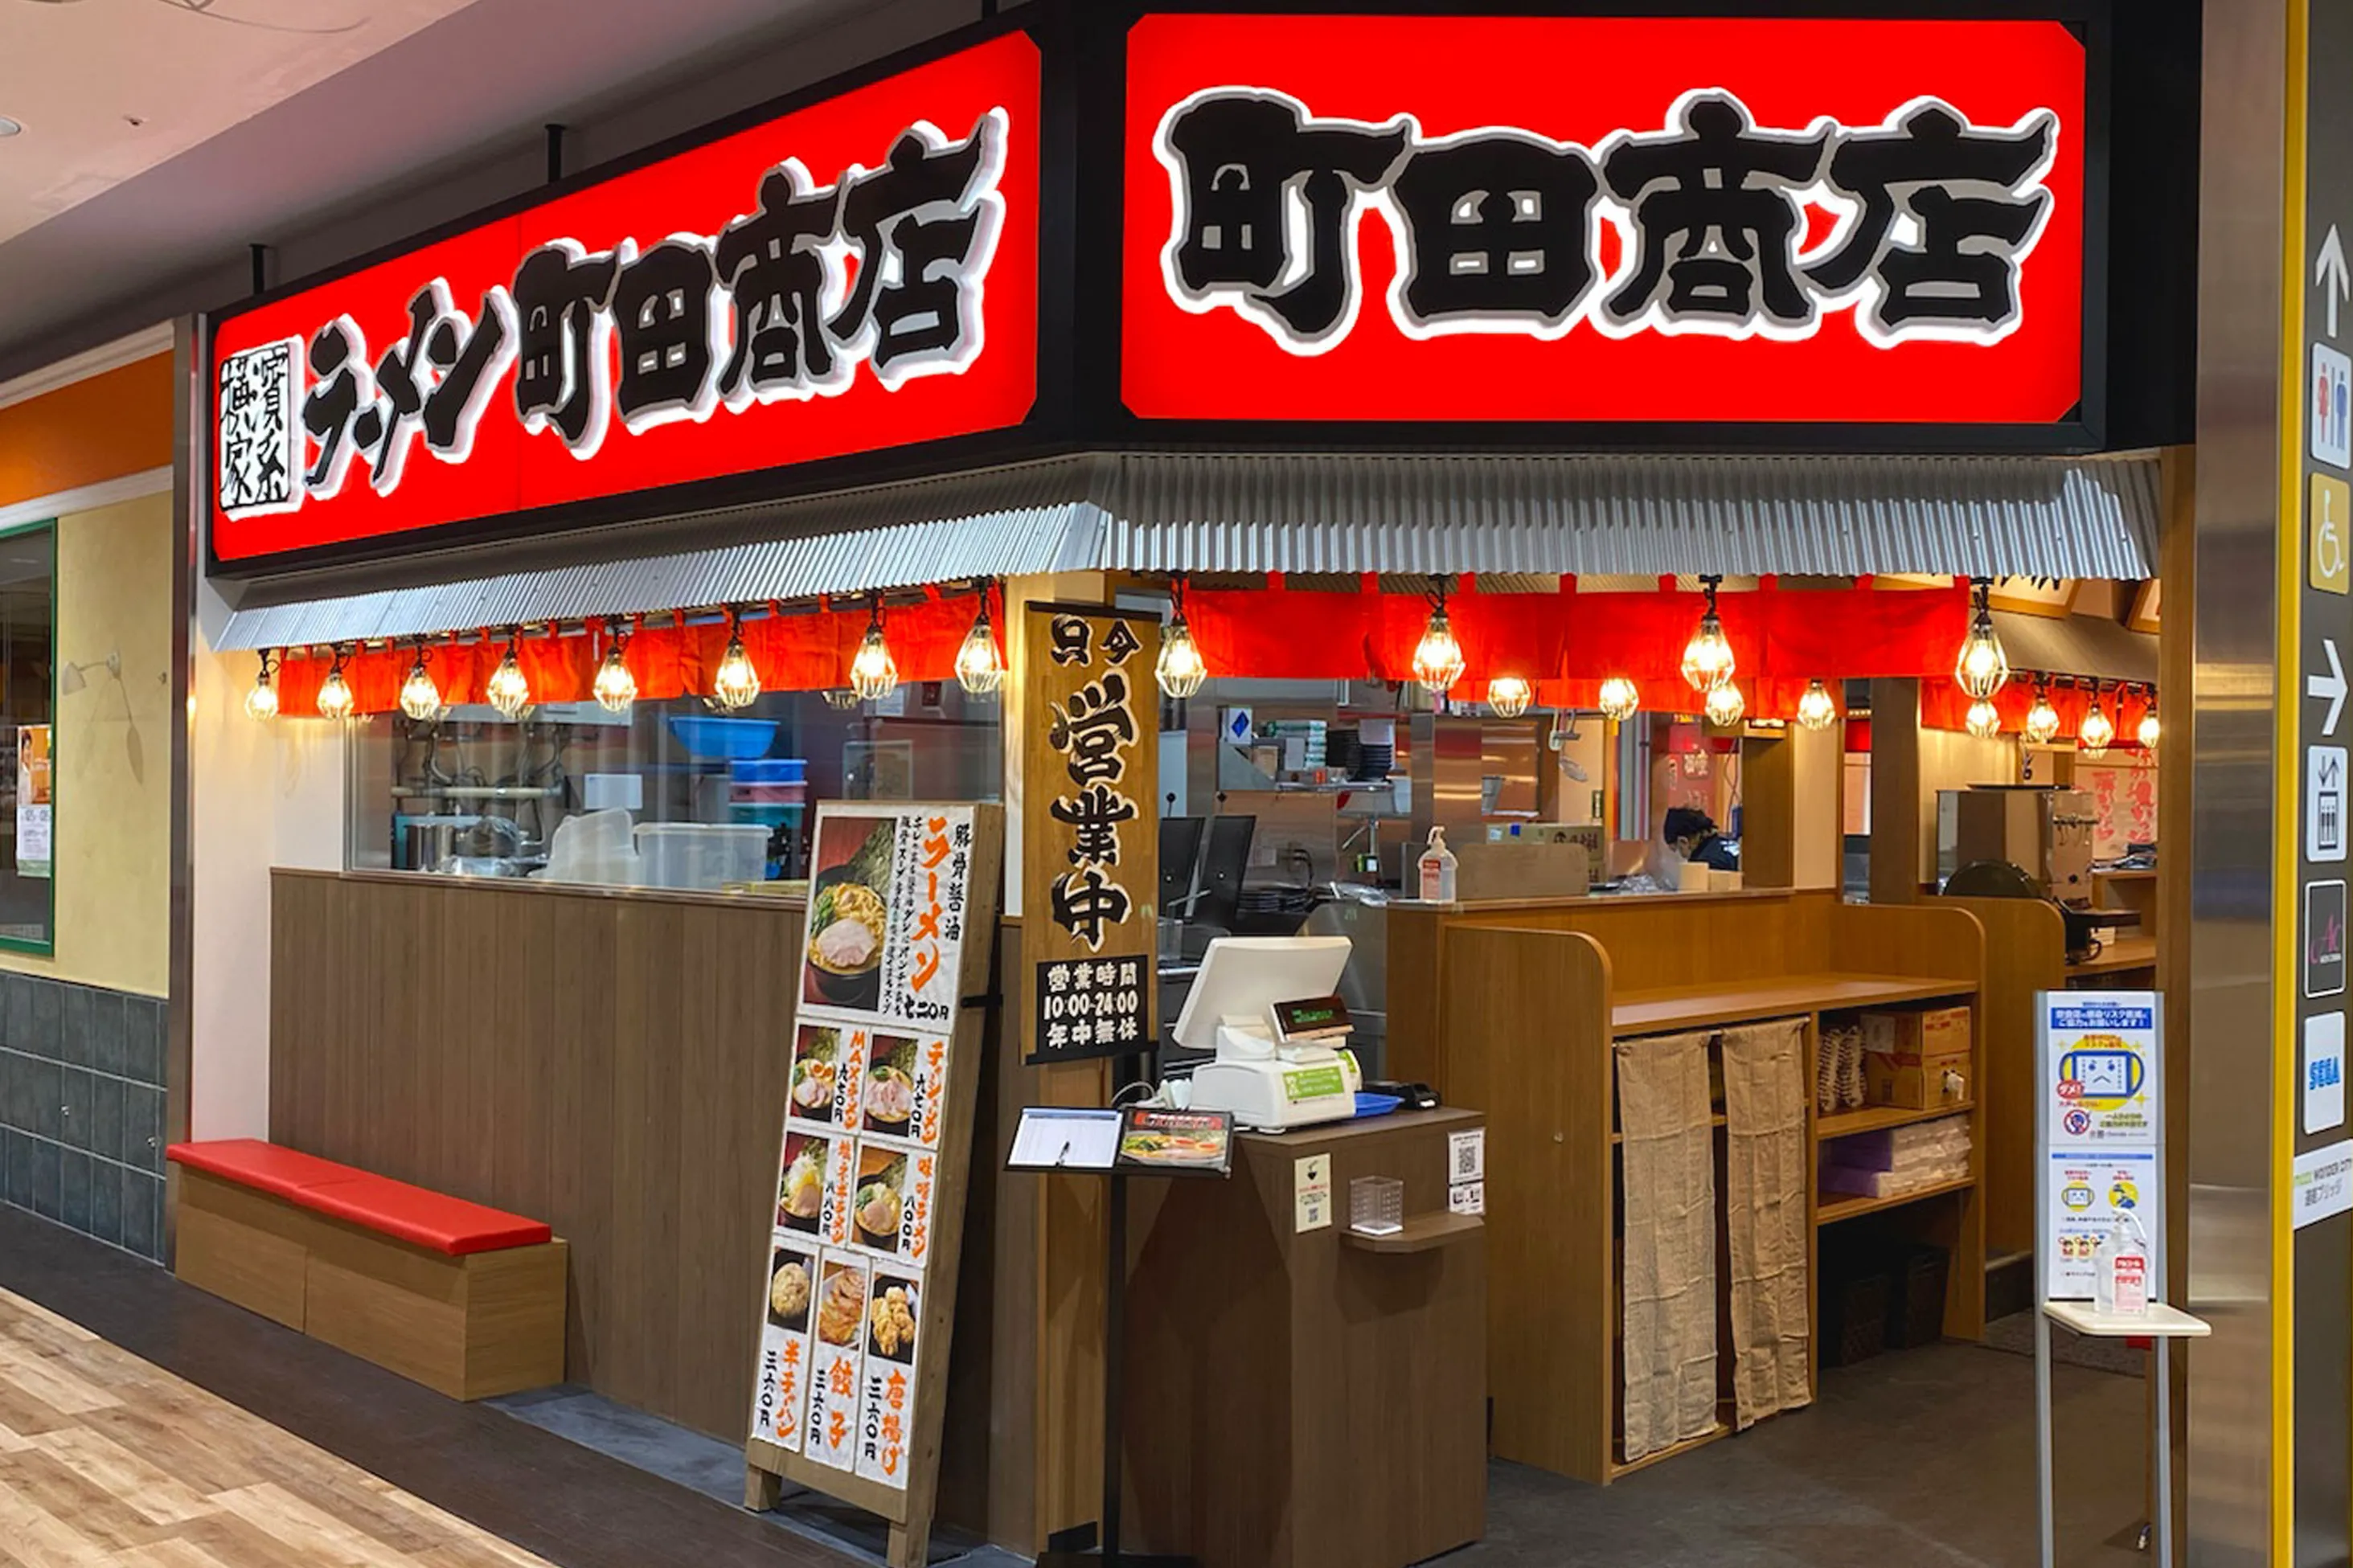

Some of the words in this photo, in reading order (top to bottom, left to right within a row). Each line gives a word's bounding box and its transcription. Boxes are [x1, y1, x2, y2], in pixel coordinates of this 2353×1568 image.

[1158, 87, 2057, 354] 町田商店
[1050, 613, 1142, 668] 只今
[1048, 667, 1141, 953] 営業中
[909, 815, 952, 994] ラーメン
[1047, 961, 1138, 993] 営業時間
[843, 1030, 866, 1130] MAXラーメン
[1046, 1015, 1138, 1049] 年中無休
[2308, 1056, 2340, 1090] SEGA
[829, 1355, 855, 1451] 餃子
[880, 1367, 908, 1476] 唐揚げ
